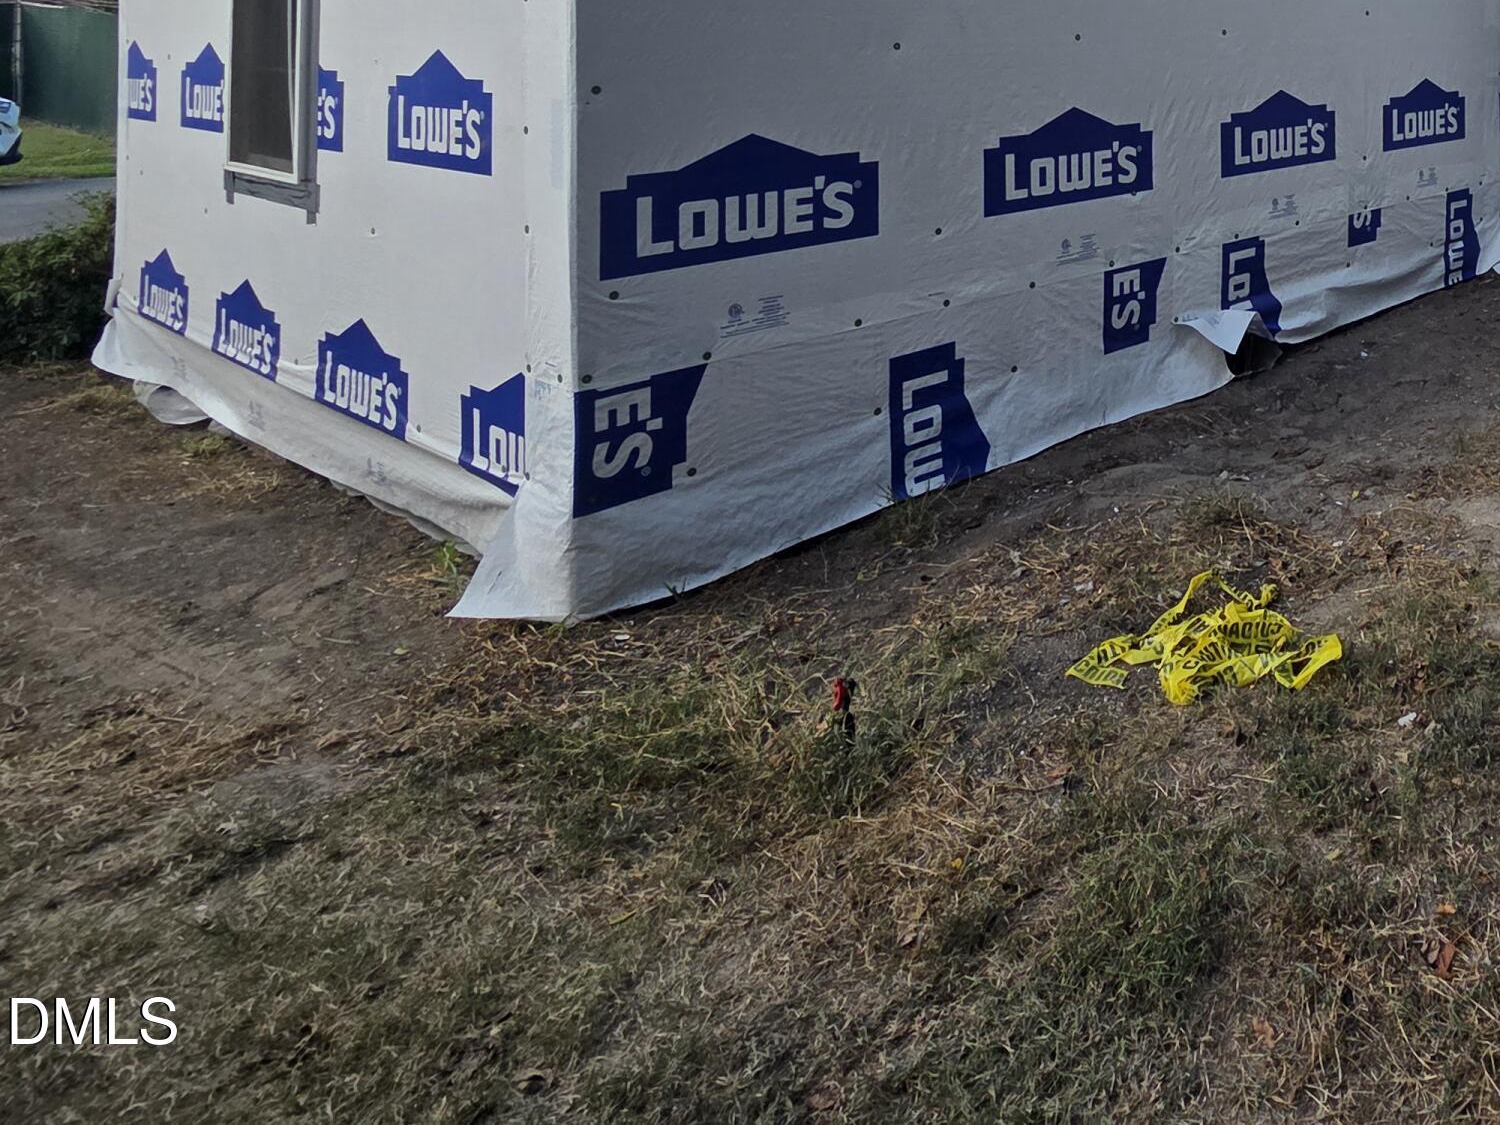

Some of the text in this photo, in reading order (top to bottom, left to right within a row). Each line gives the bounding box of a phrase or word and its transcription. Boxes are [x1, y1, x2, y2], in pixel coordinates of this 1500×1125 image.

[398, 100, 483, 161] LOWE'S
[1234, 119, 1326, 166] LOWE'S
[1392, 102, 1458, 142] LOWE'S
[1004, 141, 1139, 201] LOWE'S
[636, 175, 855, 259] LOWE'S
[143, 275, 185, 332] LOWE'S
[221, 308, 275, 375] LOWE'S
[324, 350, 400, 432] LOWE'S
